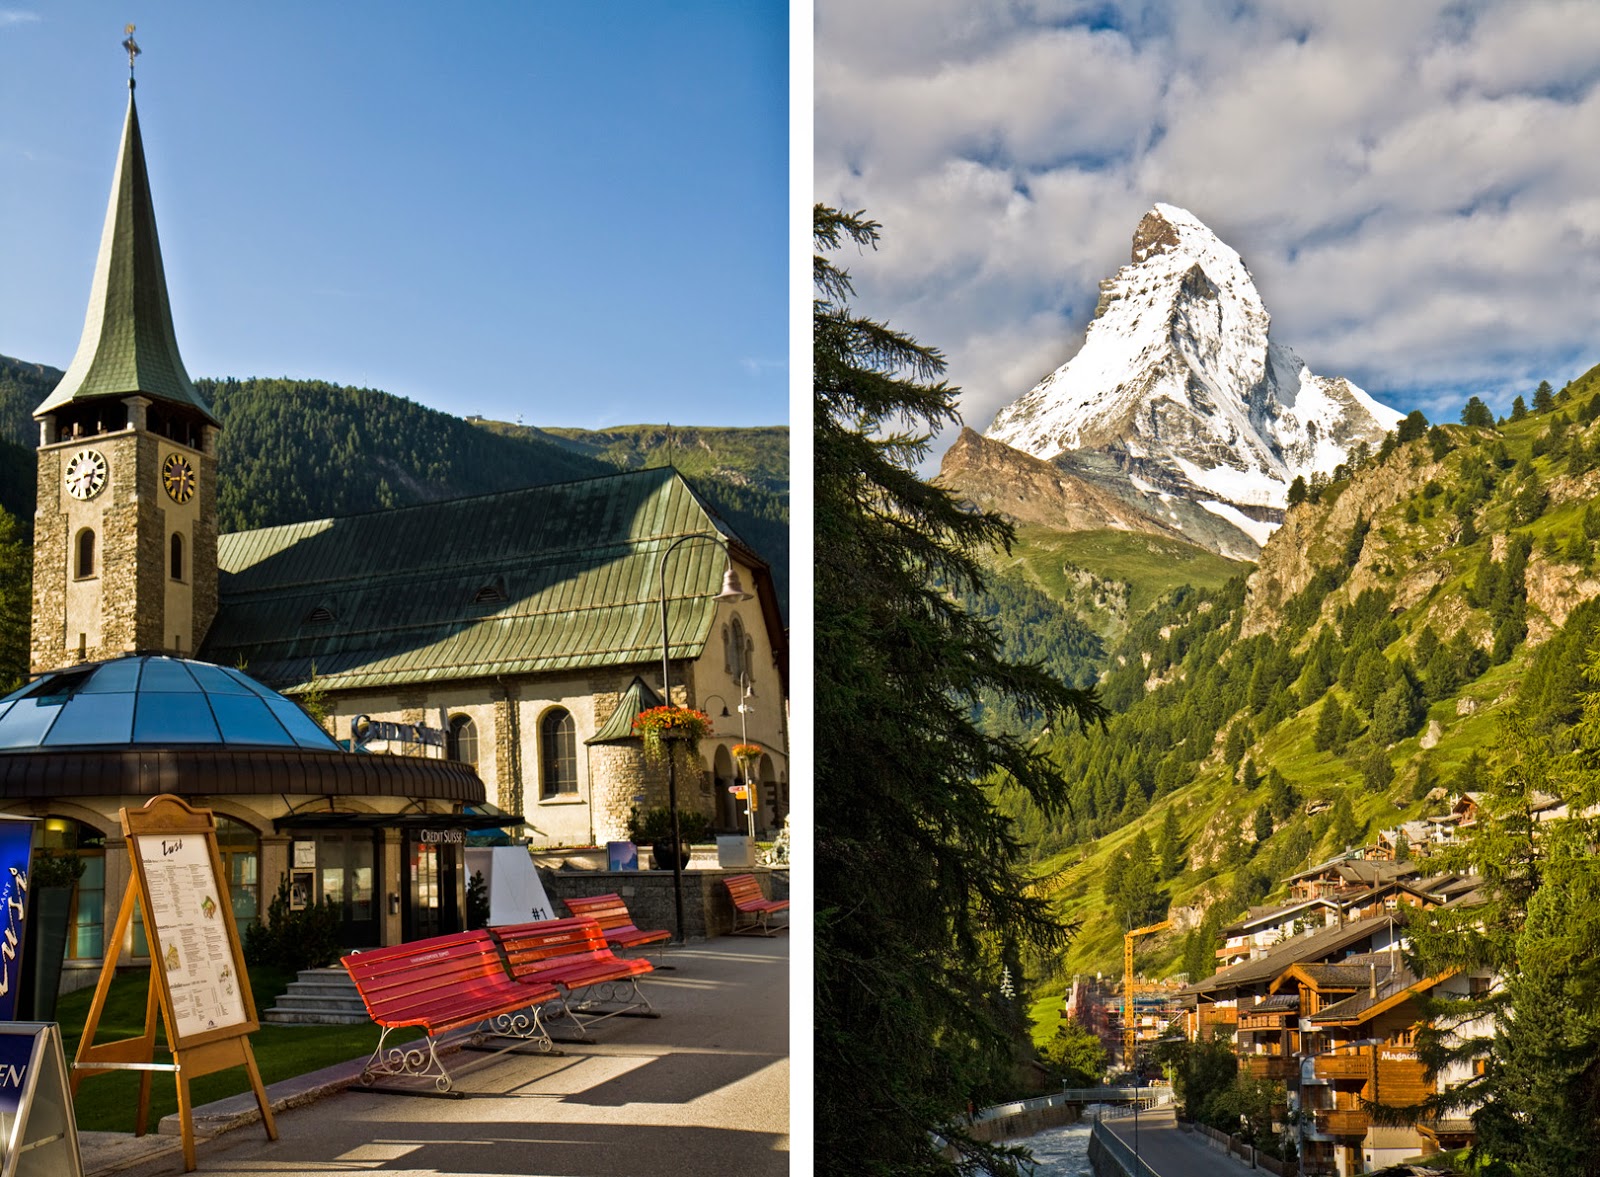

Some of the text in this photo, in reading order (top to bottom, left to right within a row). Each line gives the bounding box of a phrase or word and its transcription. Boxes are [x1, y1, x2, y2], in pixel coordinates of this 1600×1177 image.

[420, 829, 463, 843] CREDIT SUISSE
[531, 907, 548, 920] #1
